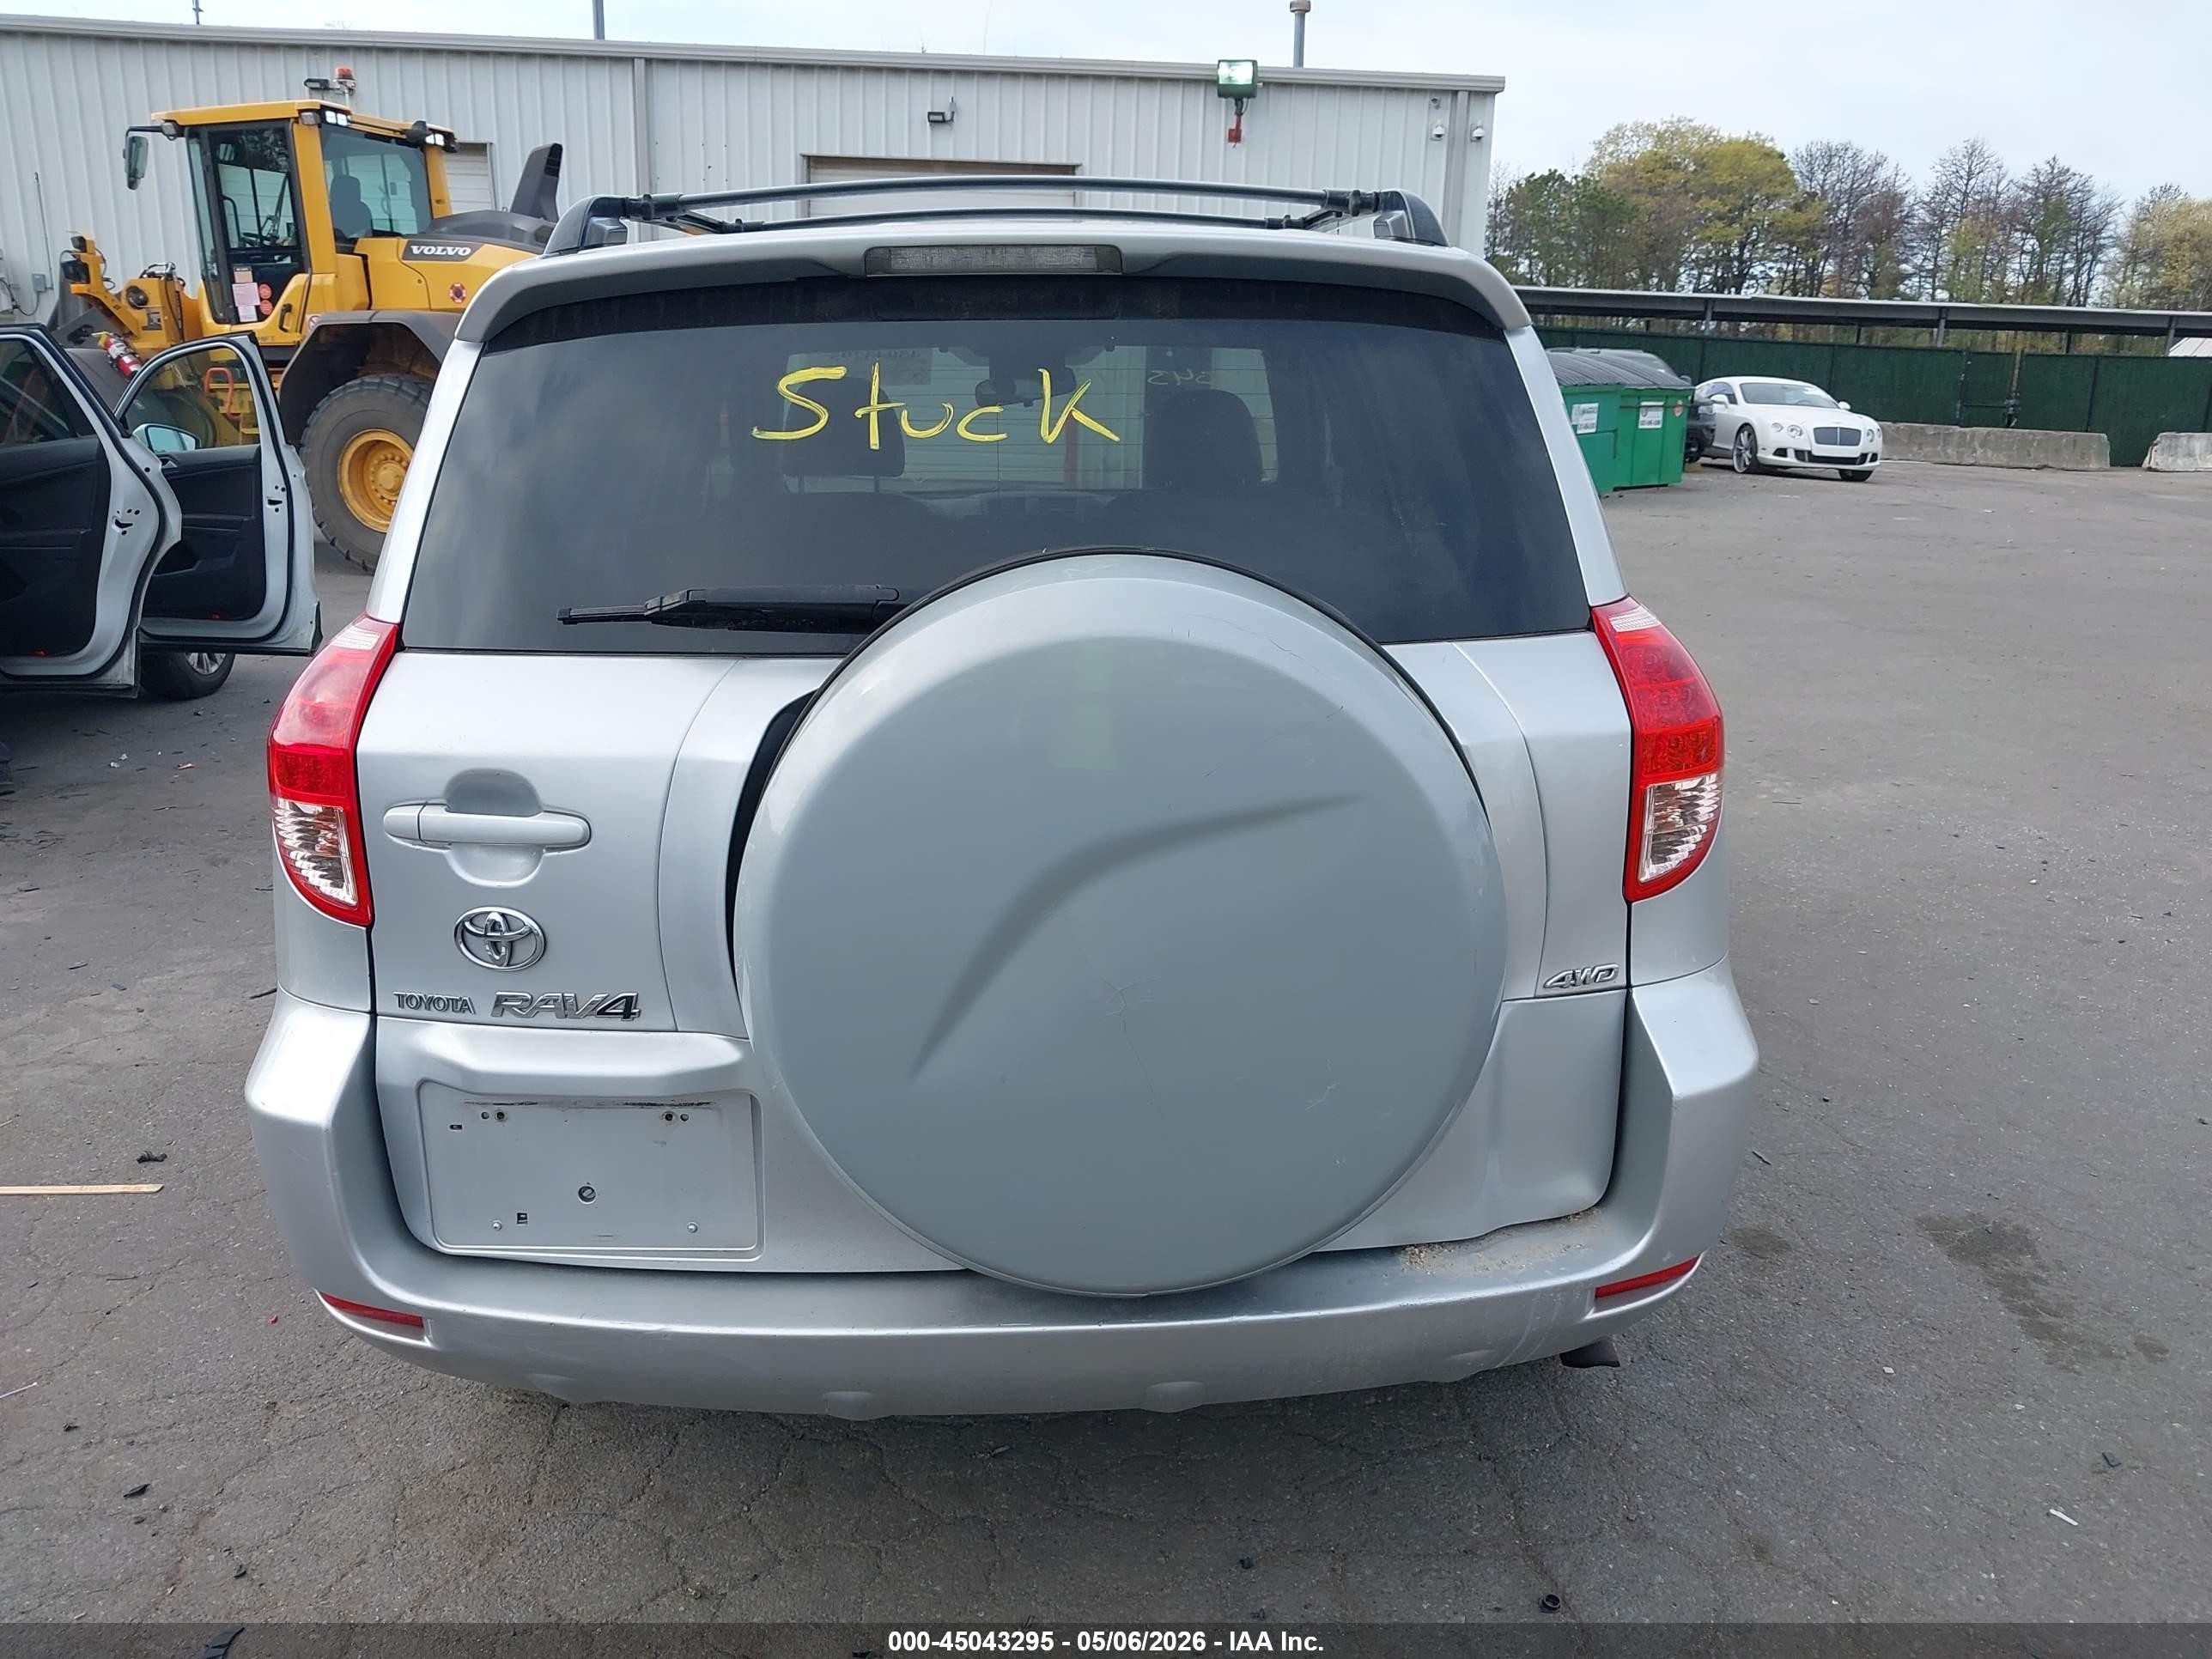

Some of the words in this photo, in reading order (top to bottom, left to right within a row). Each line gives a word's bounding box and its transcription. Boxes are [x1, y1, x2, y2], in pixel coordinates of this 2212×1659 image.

[410, 245, 471, 256] VOLVO
[1543, 963, 1619, 988] 4WD
[393, 991, 476, 1015] TOYOTA
[490, 991, 641, 1022] RAV4
